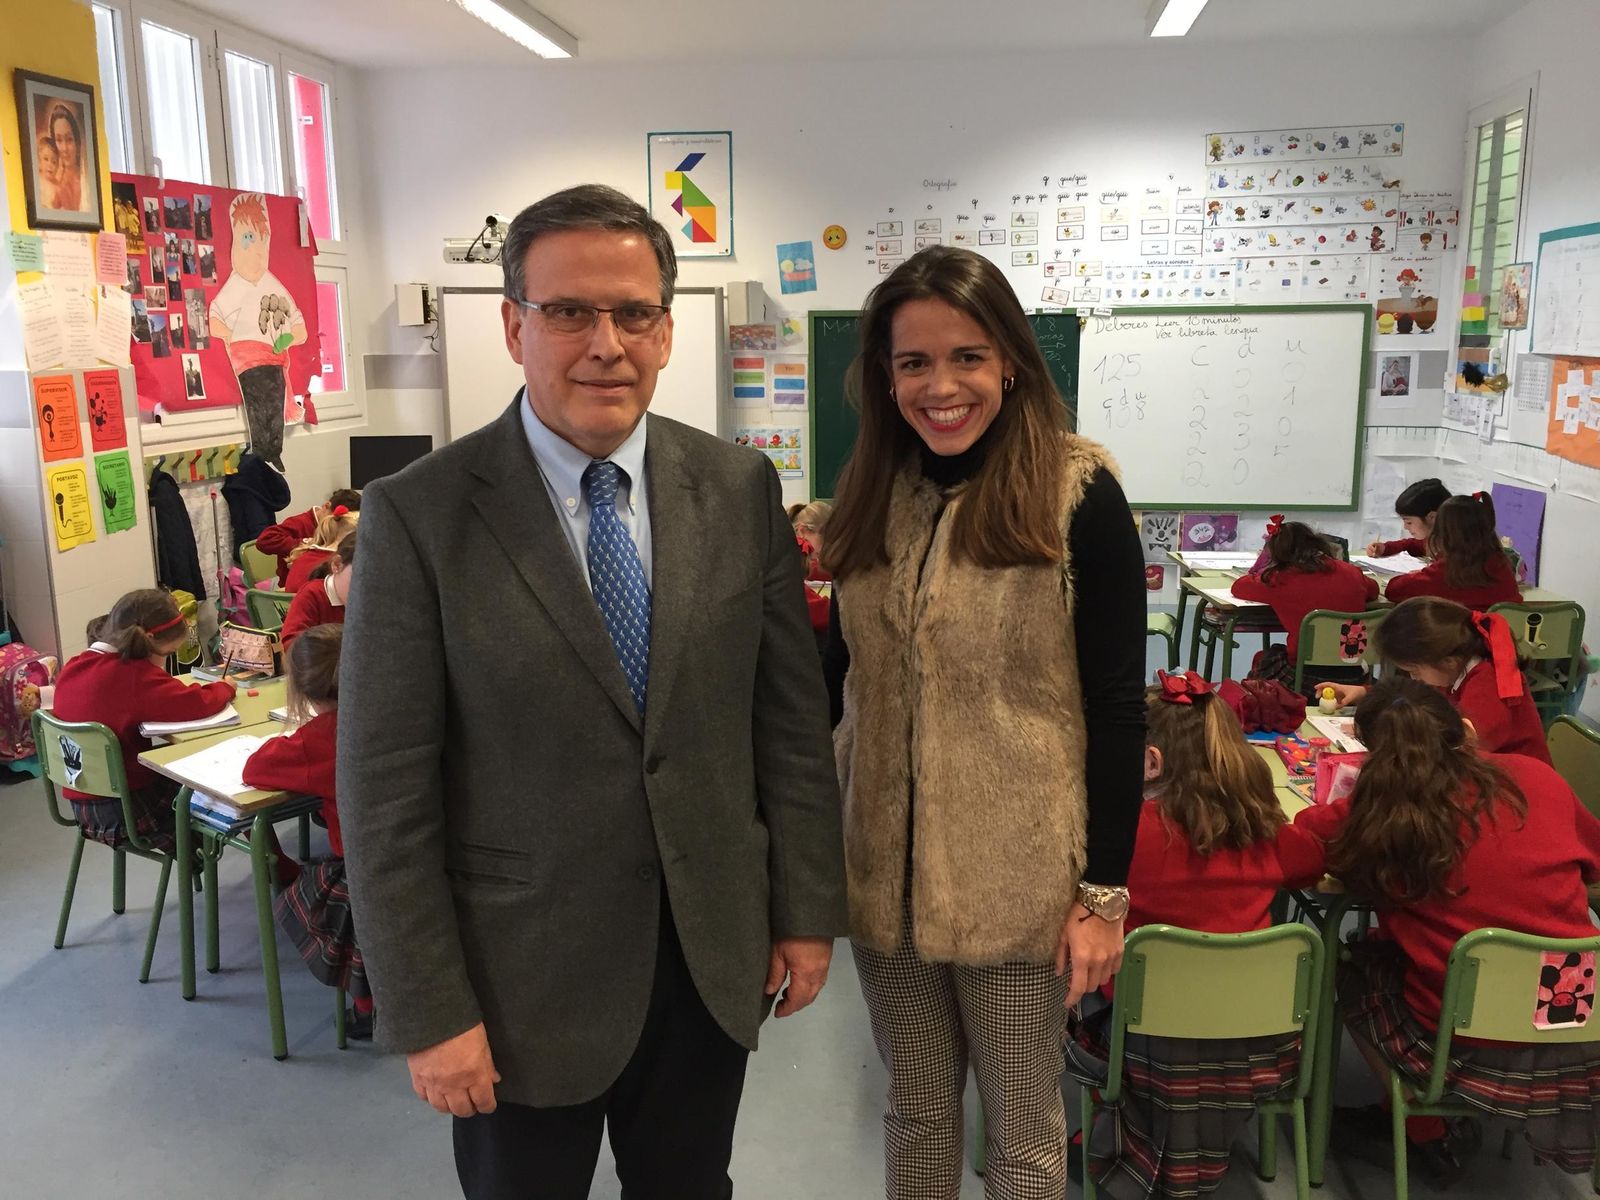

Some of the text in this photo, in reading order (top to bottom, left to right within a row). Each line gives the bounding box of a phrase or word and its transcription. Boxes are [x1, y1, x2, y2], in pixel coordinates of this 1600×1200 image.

[1178, 326, 1218, 338] libreta
[1201, 315, 1242, 326] minutos
[1237, 336, 1255, 359] d
[1093, 353, 1142, 385] 125
[1119, 388, 1129, 406] d
[1189, 405, 1208, 430] 2
[1283, 386, 1295, 406] 1
[1187, 431, 1207, 456] 2
[1278, 416, 1292, 437] 0
[56, 473, 79, 482] PORTAVOZ
[1233, 457, 1249, 486] 0
